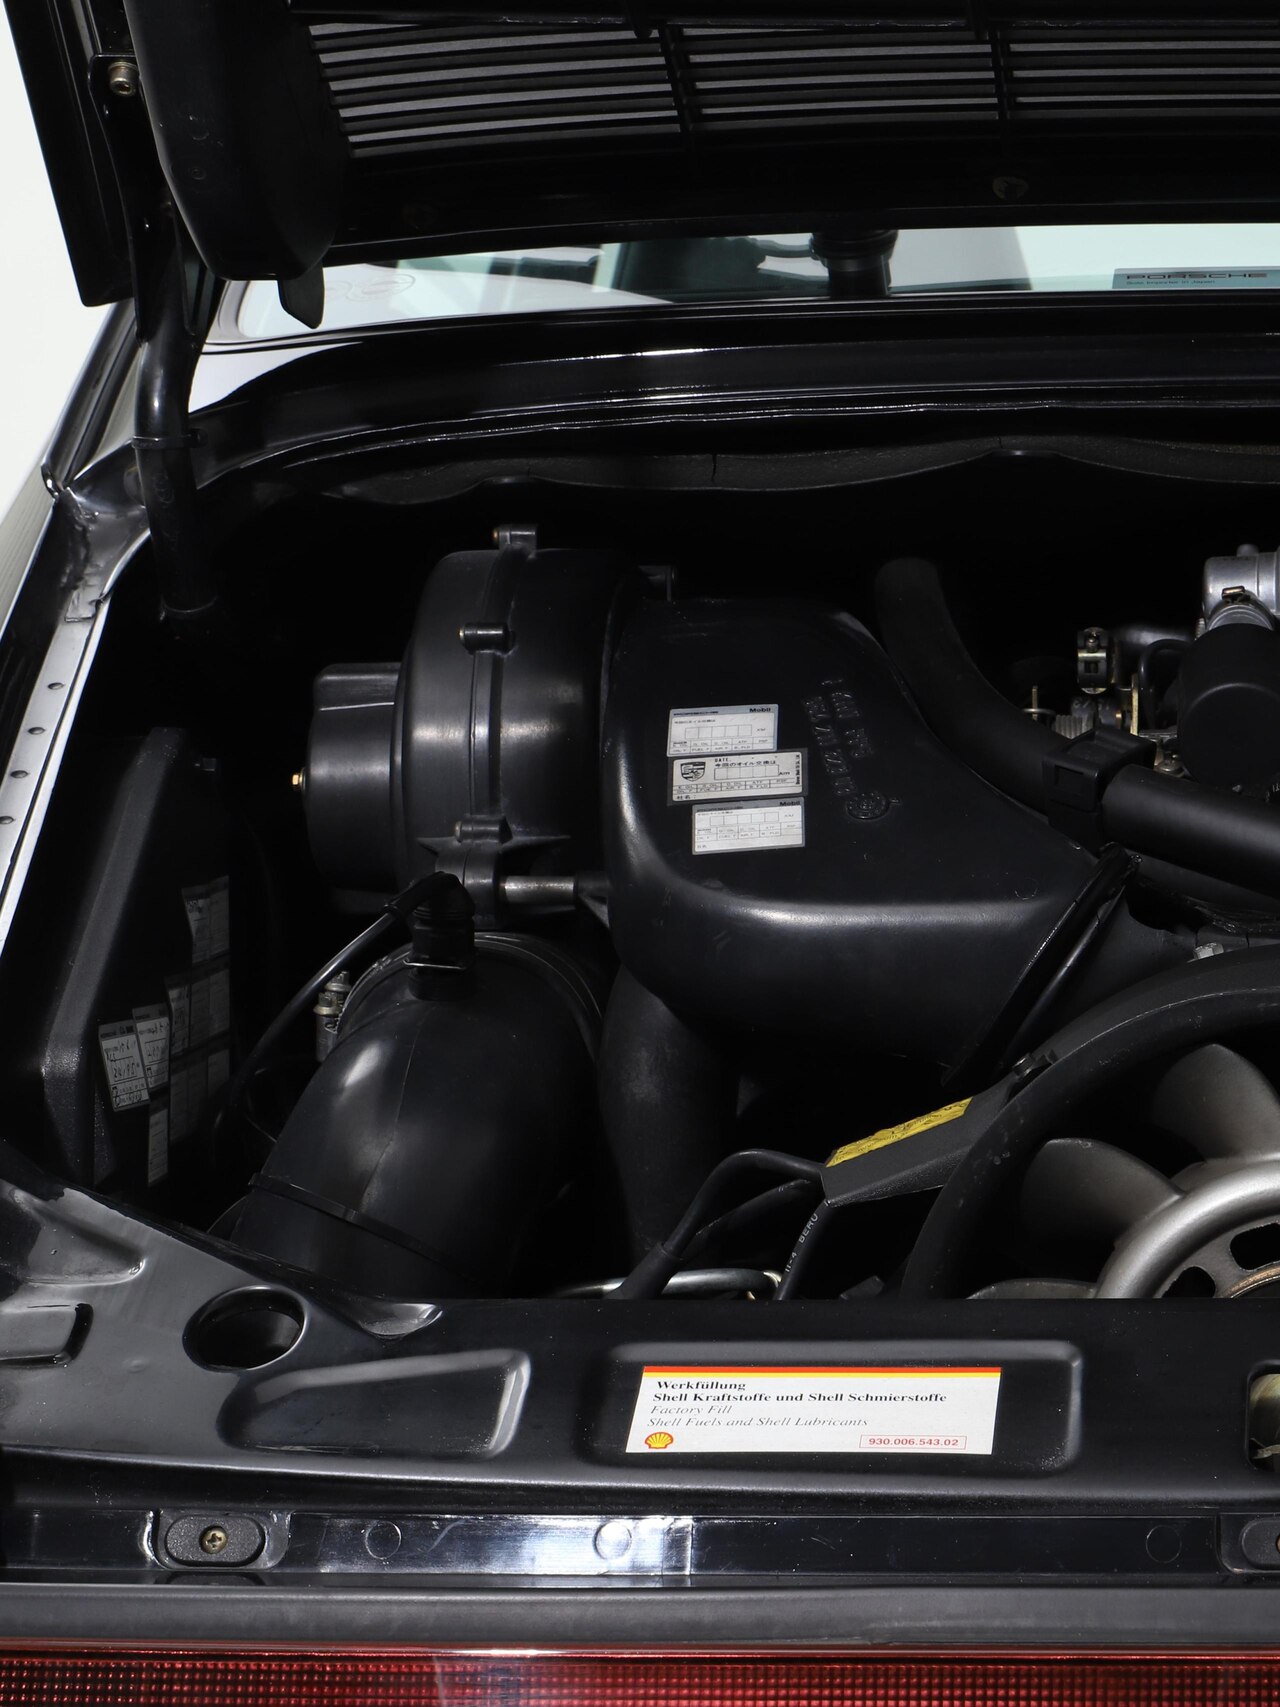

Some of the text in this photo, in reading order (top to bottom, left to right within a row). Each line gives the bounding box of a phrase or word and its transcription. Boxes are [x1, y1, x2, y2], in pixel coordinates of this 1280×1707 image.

[657, 1381, 747, 1391] Werkfüllung
[652, 1393, 947, 1402] Shell Kraftstoffe und Shell Schmierstoffe
[650, 1405, 733, 1415] Factory Fill
[648, 1417, 869, 1427] Shell Fuels and Shell Lubricants
[868, 1437, 959, 1446] 930.006.543.02
